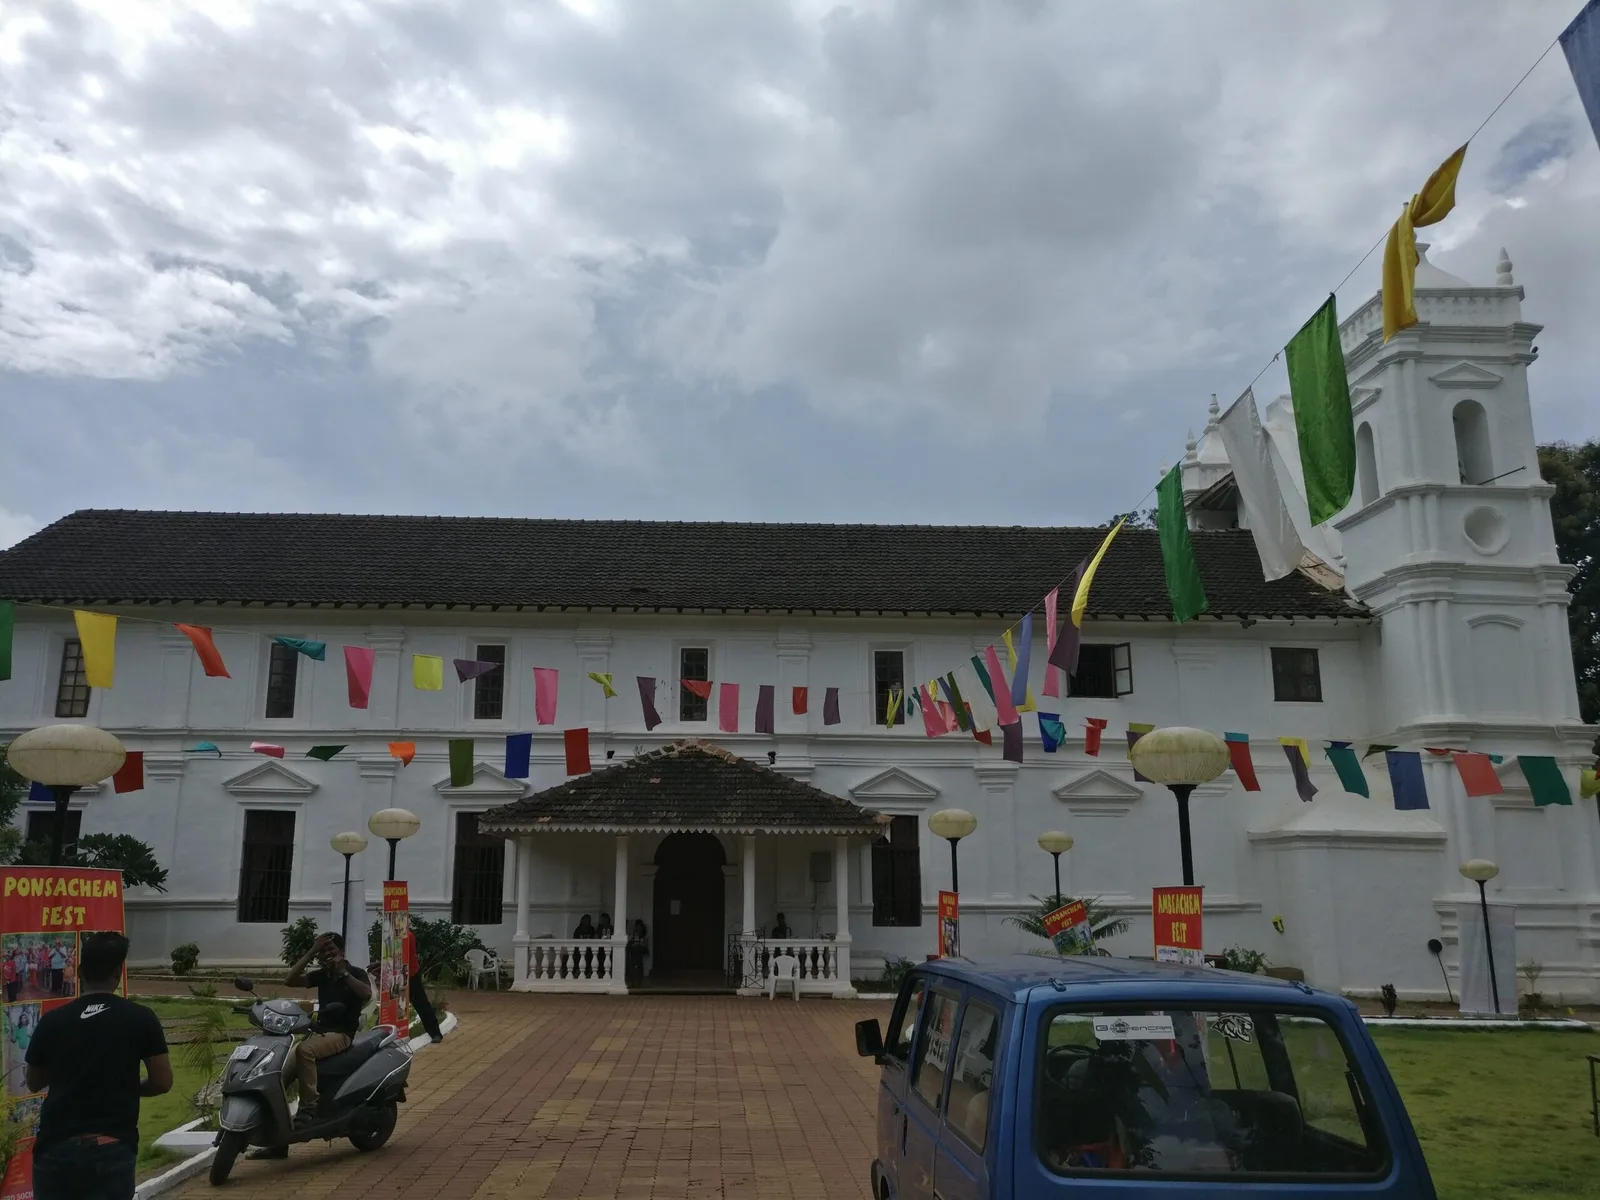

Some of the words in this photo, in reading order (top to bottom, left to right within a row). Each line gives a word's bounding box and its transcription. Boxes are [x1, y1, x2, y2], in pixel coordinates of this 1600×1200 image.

[4, 876, 118, 898] PONSACHEM
[42, 905, 86, 927] FEST
[1171, 921, 1187, 943] FEST
[85, 1003, 106, 1013] NIKE
